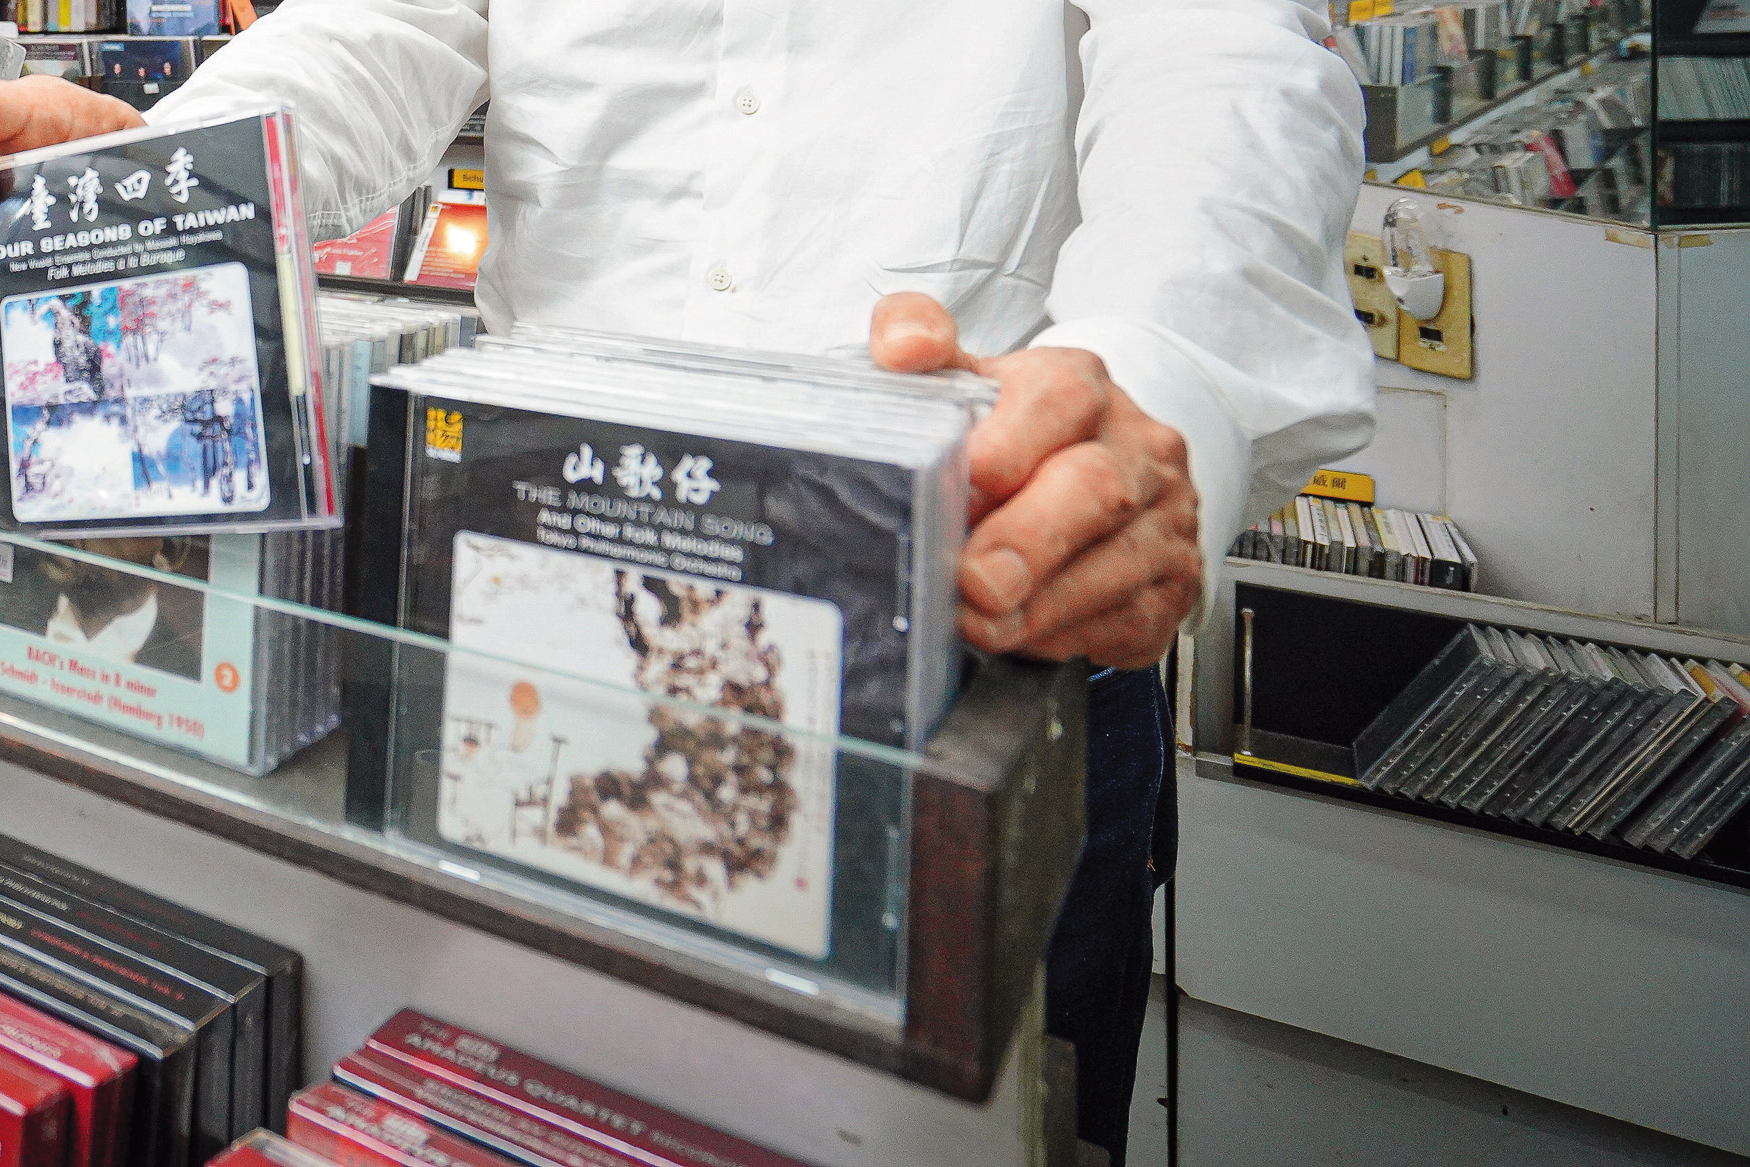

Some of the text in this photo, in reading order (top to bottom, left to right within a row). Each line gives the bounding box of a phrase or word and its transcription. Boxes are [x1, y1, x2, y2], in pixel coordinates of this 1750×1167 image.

[30, 146, 199, 231] 臺灣四季
[40, 223, 133, 253] SEASONS
[138, 217, 167, 237] OF
[172, 202, 256, 232] TAIWAN
[47, 266, 70, 281] Folk
[562, 442, 722, 506] 山歌仔
[512, 480, 775, 546] THE MOUNTAIN SONG
[537, 507, 572, 529] And
[573, 513, 621, 539] Other
[0, 662, 40, 685] Schmidt
[68, 659, 97, 680] Mass
[125, 678, 158, 698] minor
[405, 1031, 519, 1087] AMADEUS
[523, 1078, 646, 1135] QUARTET
